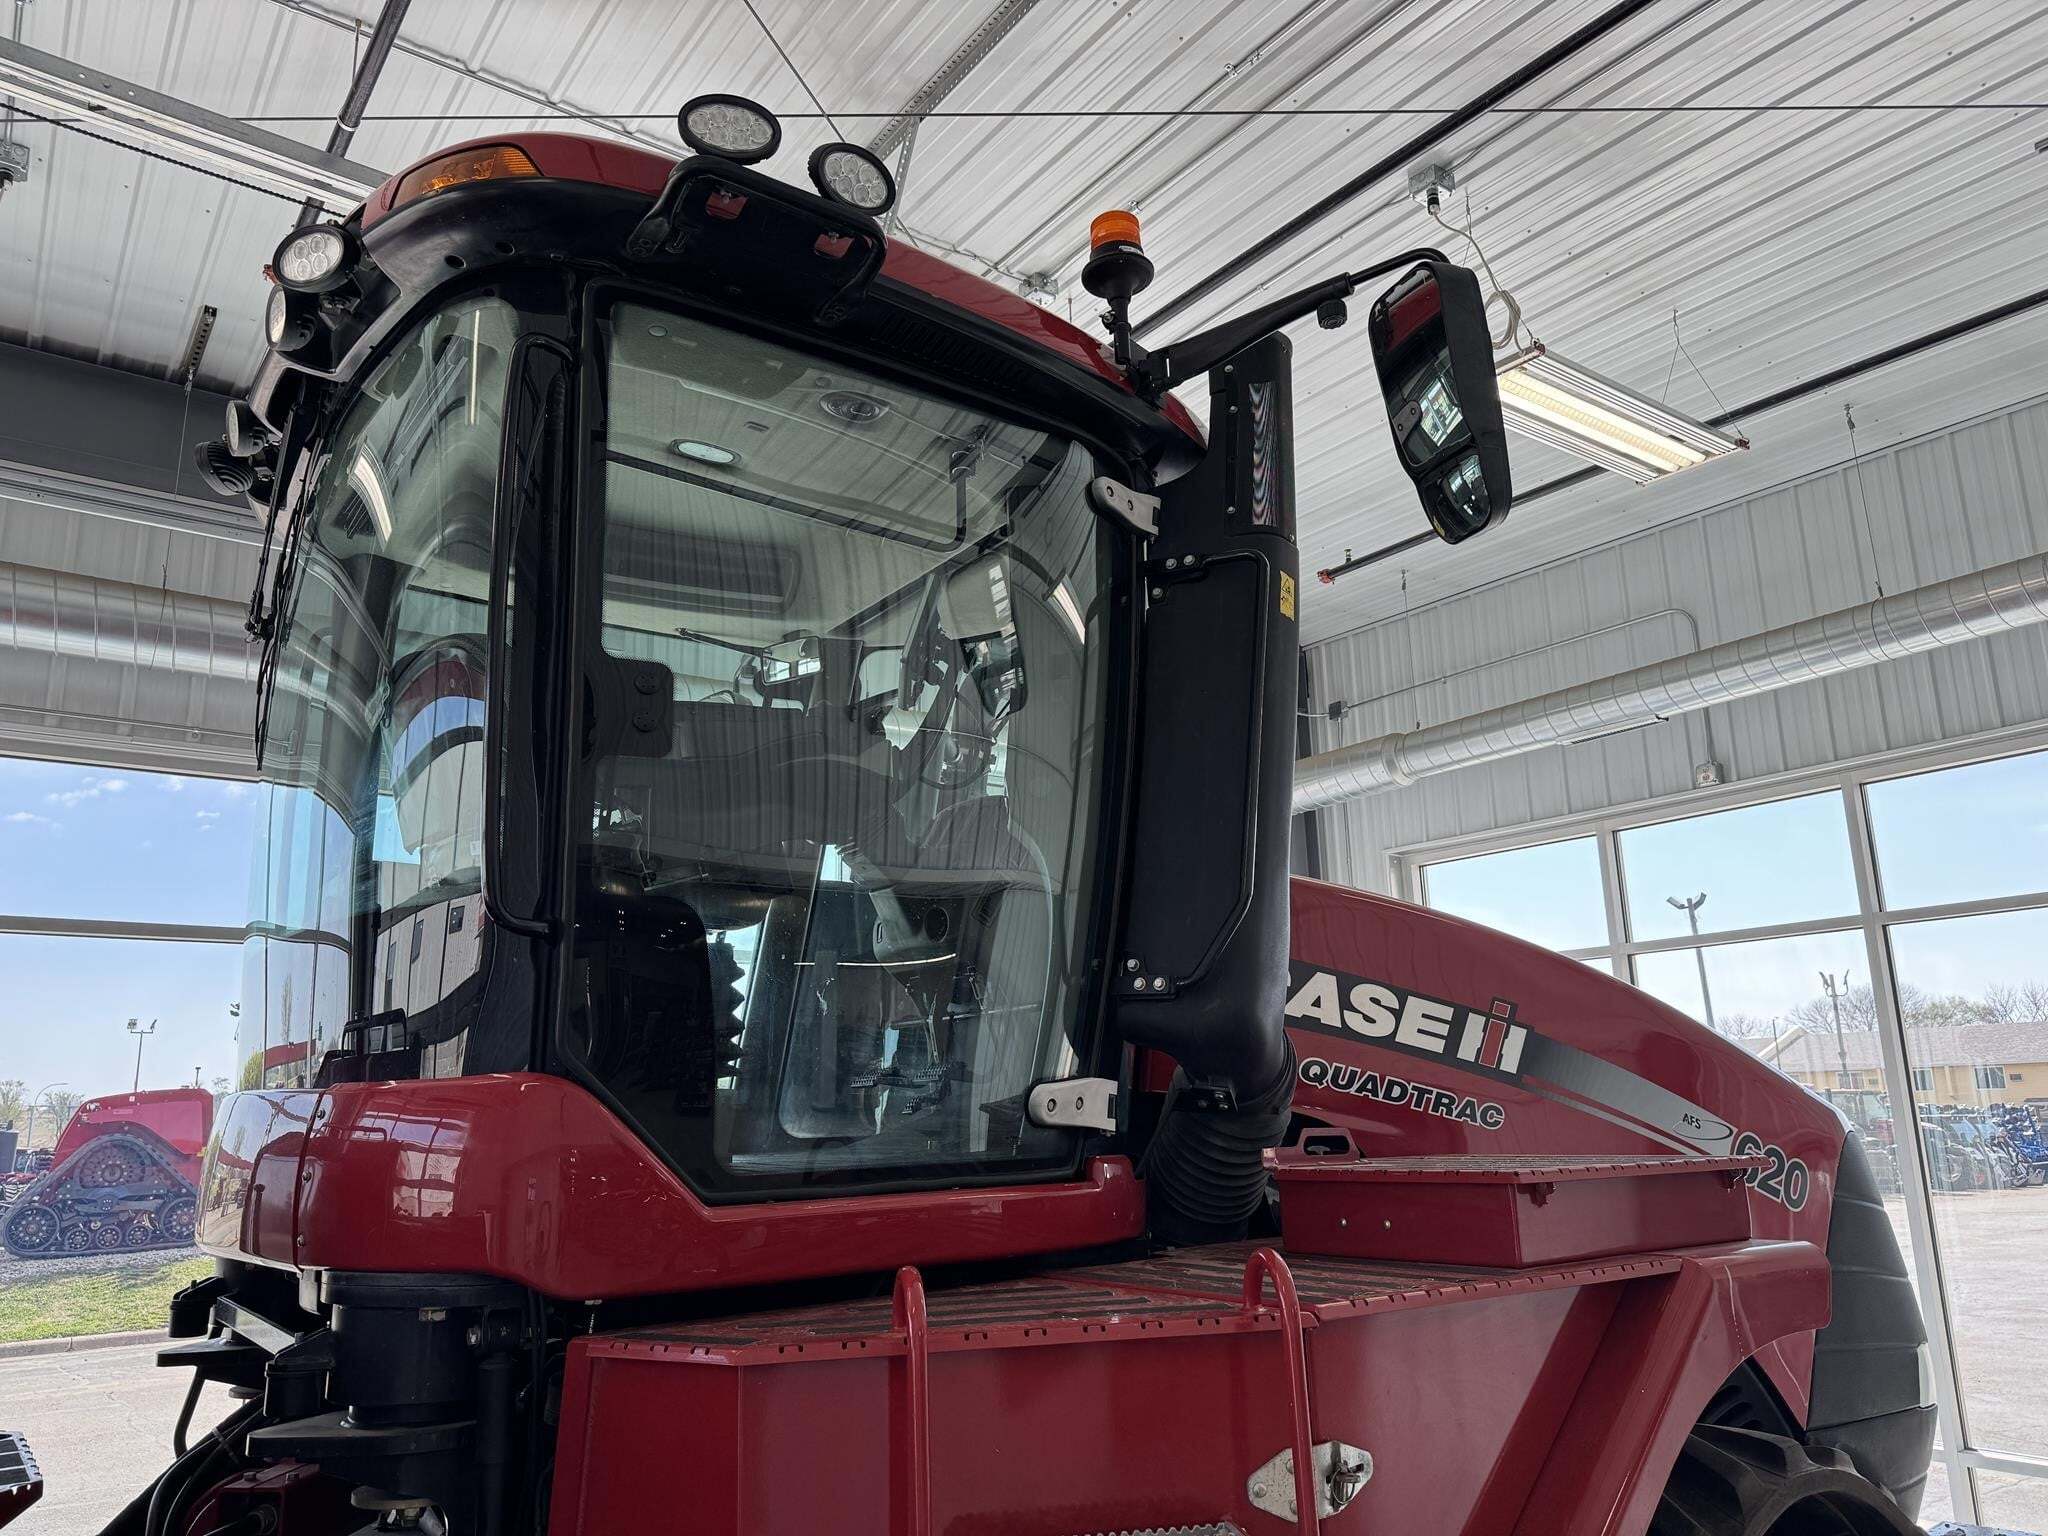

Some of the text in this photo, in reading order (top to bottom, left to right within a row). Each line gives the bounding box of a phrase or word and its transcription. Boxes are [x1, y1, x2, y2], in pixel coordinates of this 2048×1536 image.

[1284, 971, 1454, 1054] ASE
[1299, 1057, 1505, 1130] QUADTRAC
[1682, 1112, 1701, 1130] AFS
